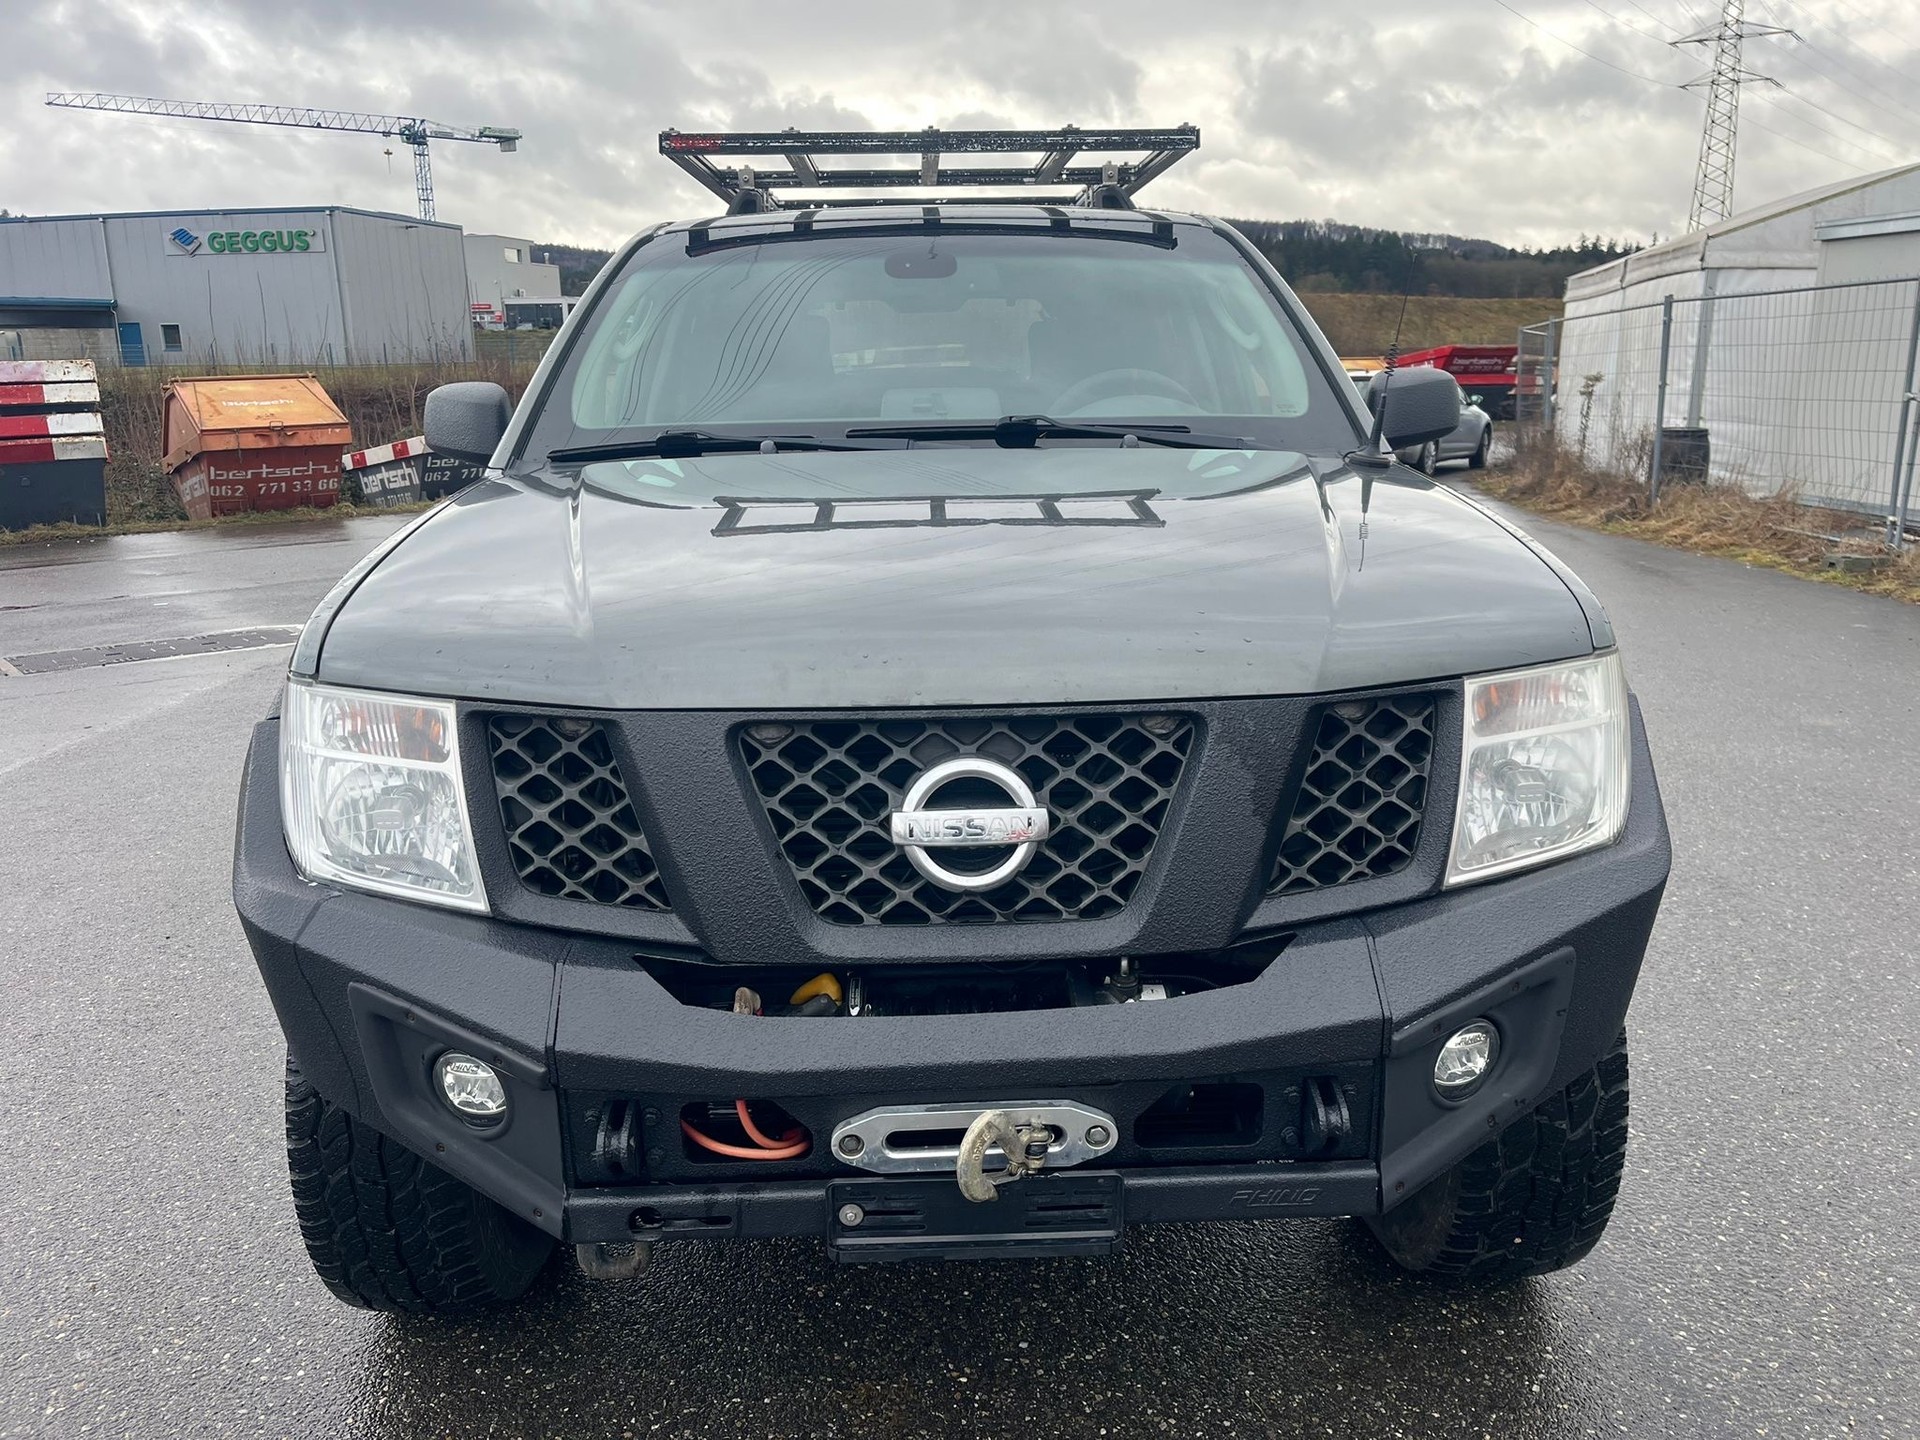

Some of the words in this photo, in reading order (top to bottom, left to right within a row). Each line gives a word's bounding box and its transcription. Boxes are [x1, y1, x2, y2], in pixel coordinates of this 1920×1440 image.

[207, 231, 311, 253] GEGGUS
[209, 459, 339, 480] bertschi
[359, 460, 420, 495] bertschi
[424, 471, 451, 482] 062
[210, 485, 244, 497] 062
[258, 482, 287, 495] 771
[292, 481, 312, 493] 33
[317, 478, 338, 491] 66
[907, 815, 1037, 841] NISSAN
